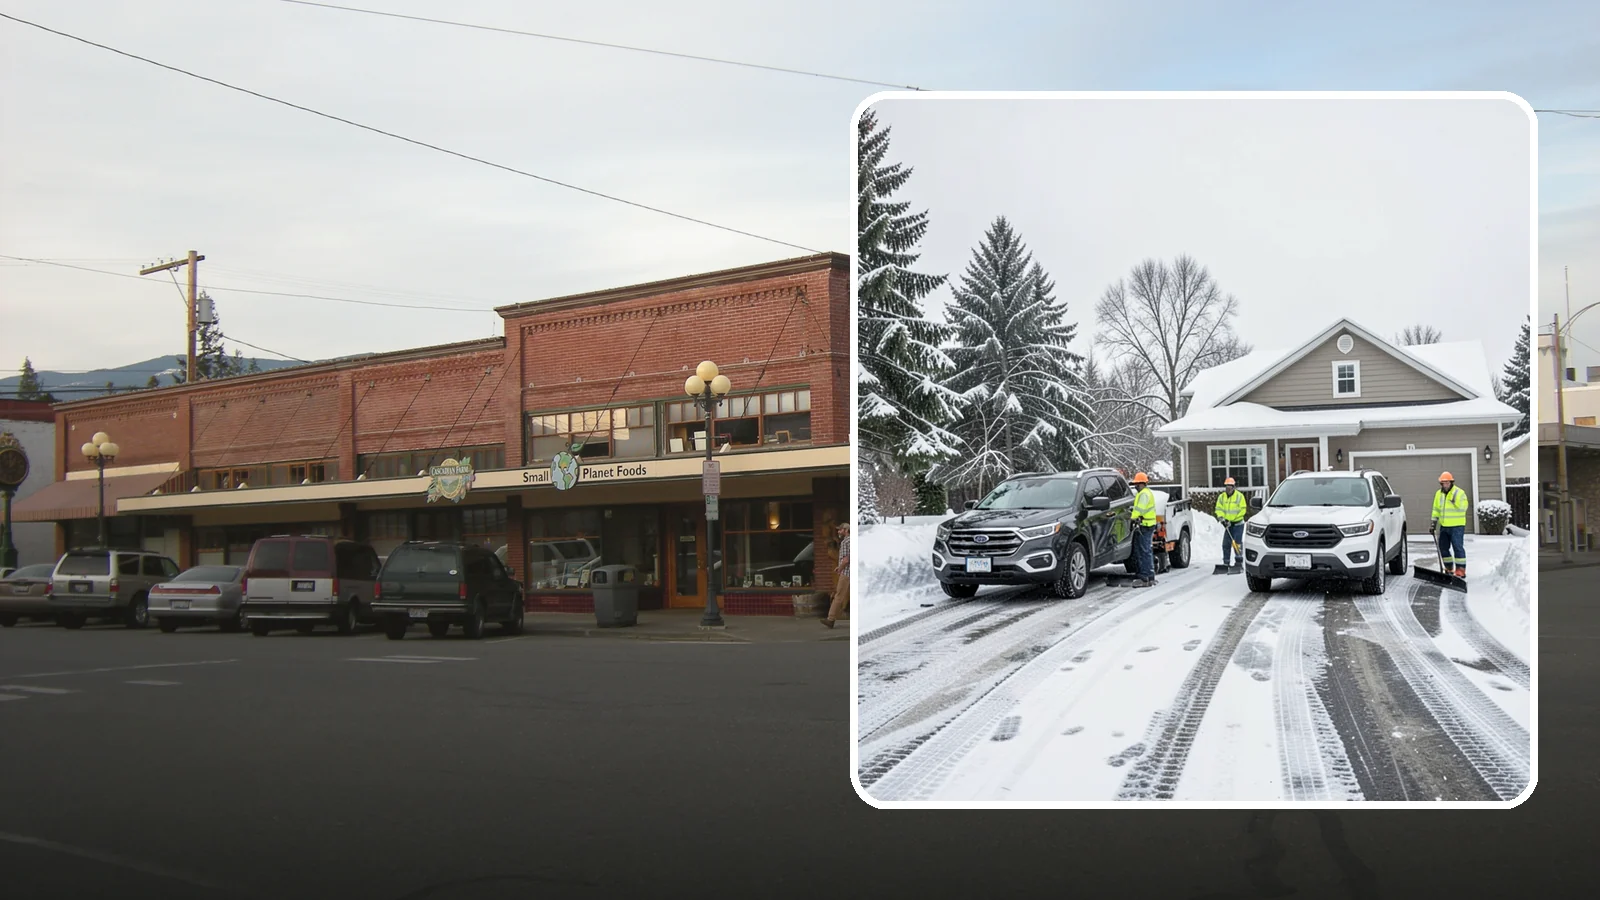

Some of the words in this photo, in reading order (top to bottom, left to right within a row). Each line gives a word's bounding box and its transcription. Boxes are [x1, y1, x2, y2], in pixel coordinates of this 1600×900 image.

[456, 466, 469, 474] FARM
[523, 471, 549, 483] Small
[583, 467, 614, 479] Planet
[617, 464, 647, 477] Foods
